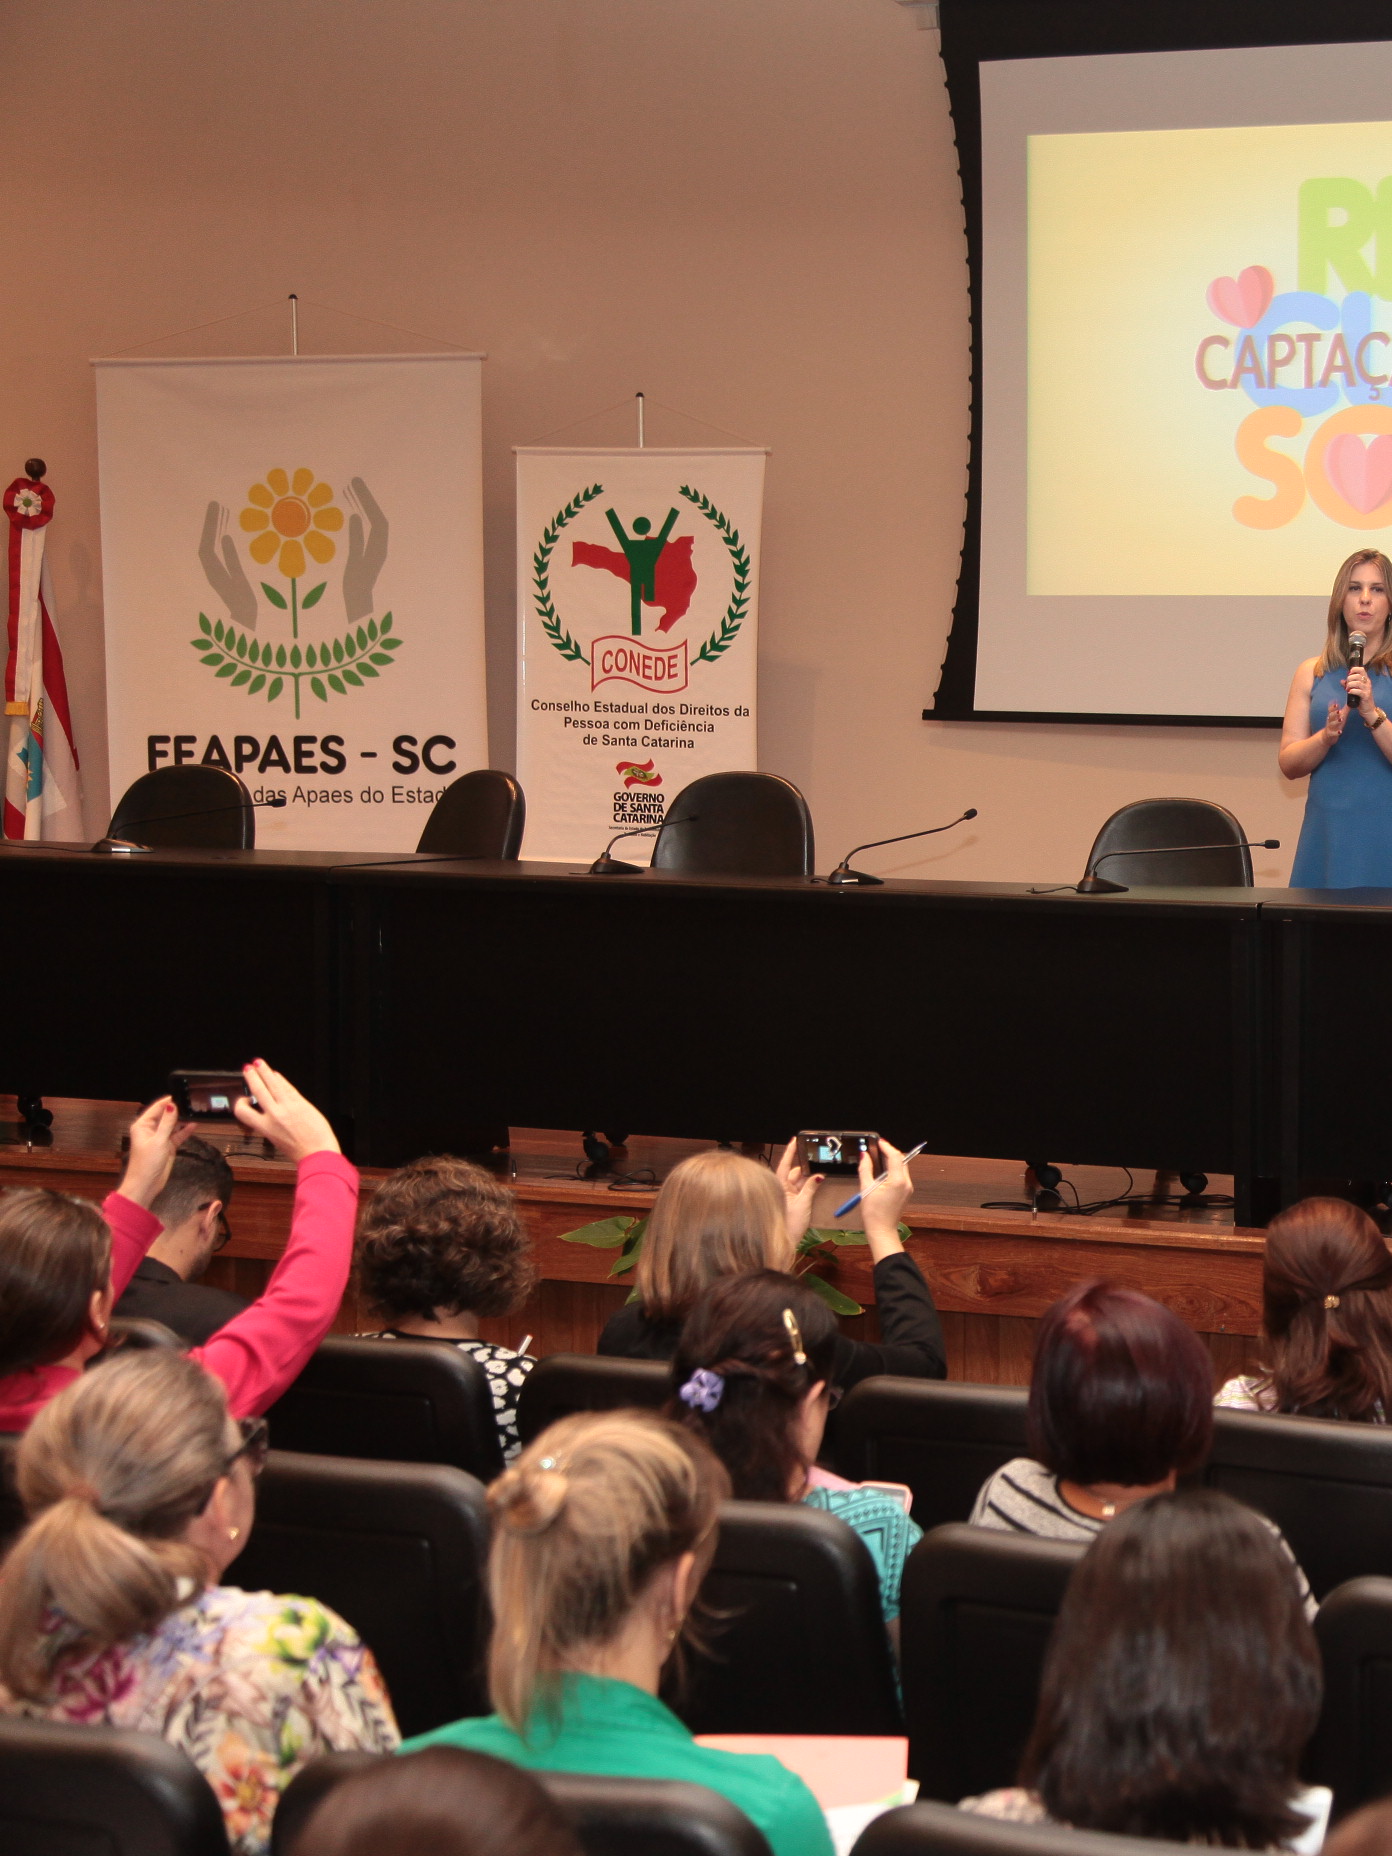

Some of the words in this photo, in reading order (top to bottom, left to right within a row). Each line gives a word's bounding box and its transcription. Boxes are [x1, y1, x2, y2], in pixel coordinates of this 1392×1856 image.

[601, 648, 678, 681] CONEDE
[531, 699, 590, 712] Conselho
[594, 701, 648, 714] Estadual
[652, 703, 675, 715] dos
[680, 703, 729, 716] Direitos
[734, 705, 750, 717] da
[564, 716, 609, 729] Pessoa
[613, 720, 640, 730] com
[644, 719, 714, 732] Deficiência
[583, 734, 598, 745] de
[602, 735, 637, 747] Santa
[641, 736, 695, 749] Catarina
[392, 734, 457, 775] SC
[254, 786, 287, 803] das
[292, 786, 353, 808] Apaes
[360, 786, 384, 803] do
[613, 792, 665, 803] GOVERNO
[613, 803, 627, 812] DE
[630, 803, 664, 814] SANTA
[613, 813, 665, 824] CATARINA
